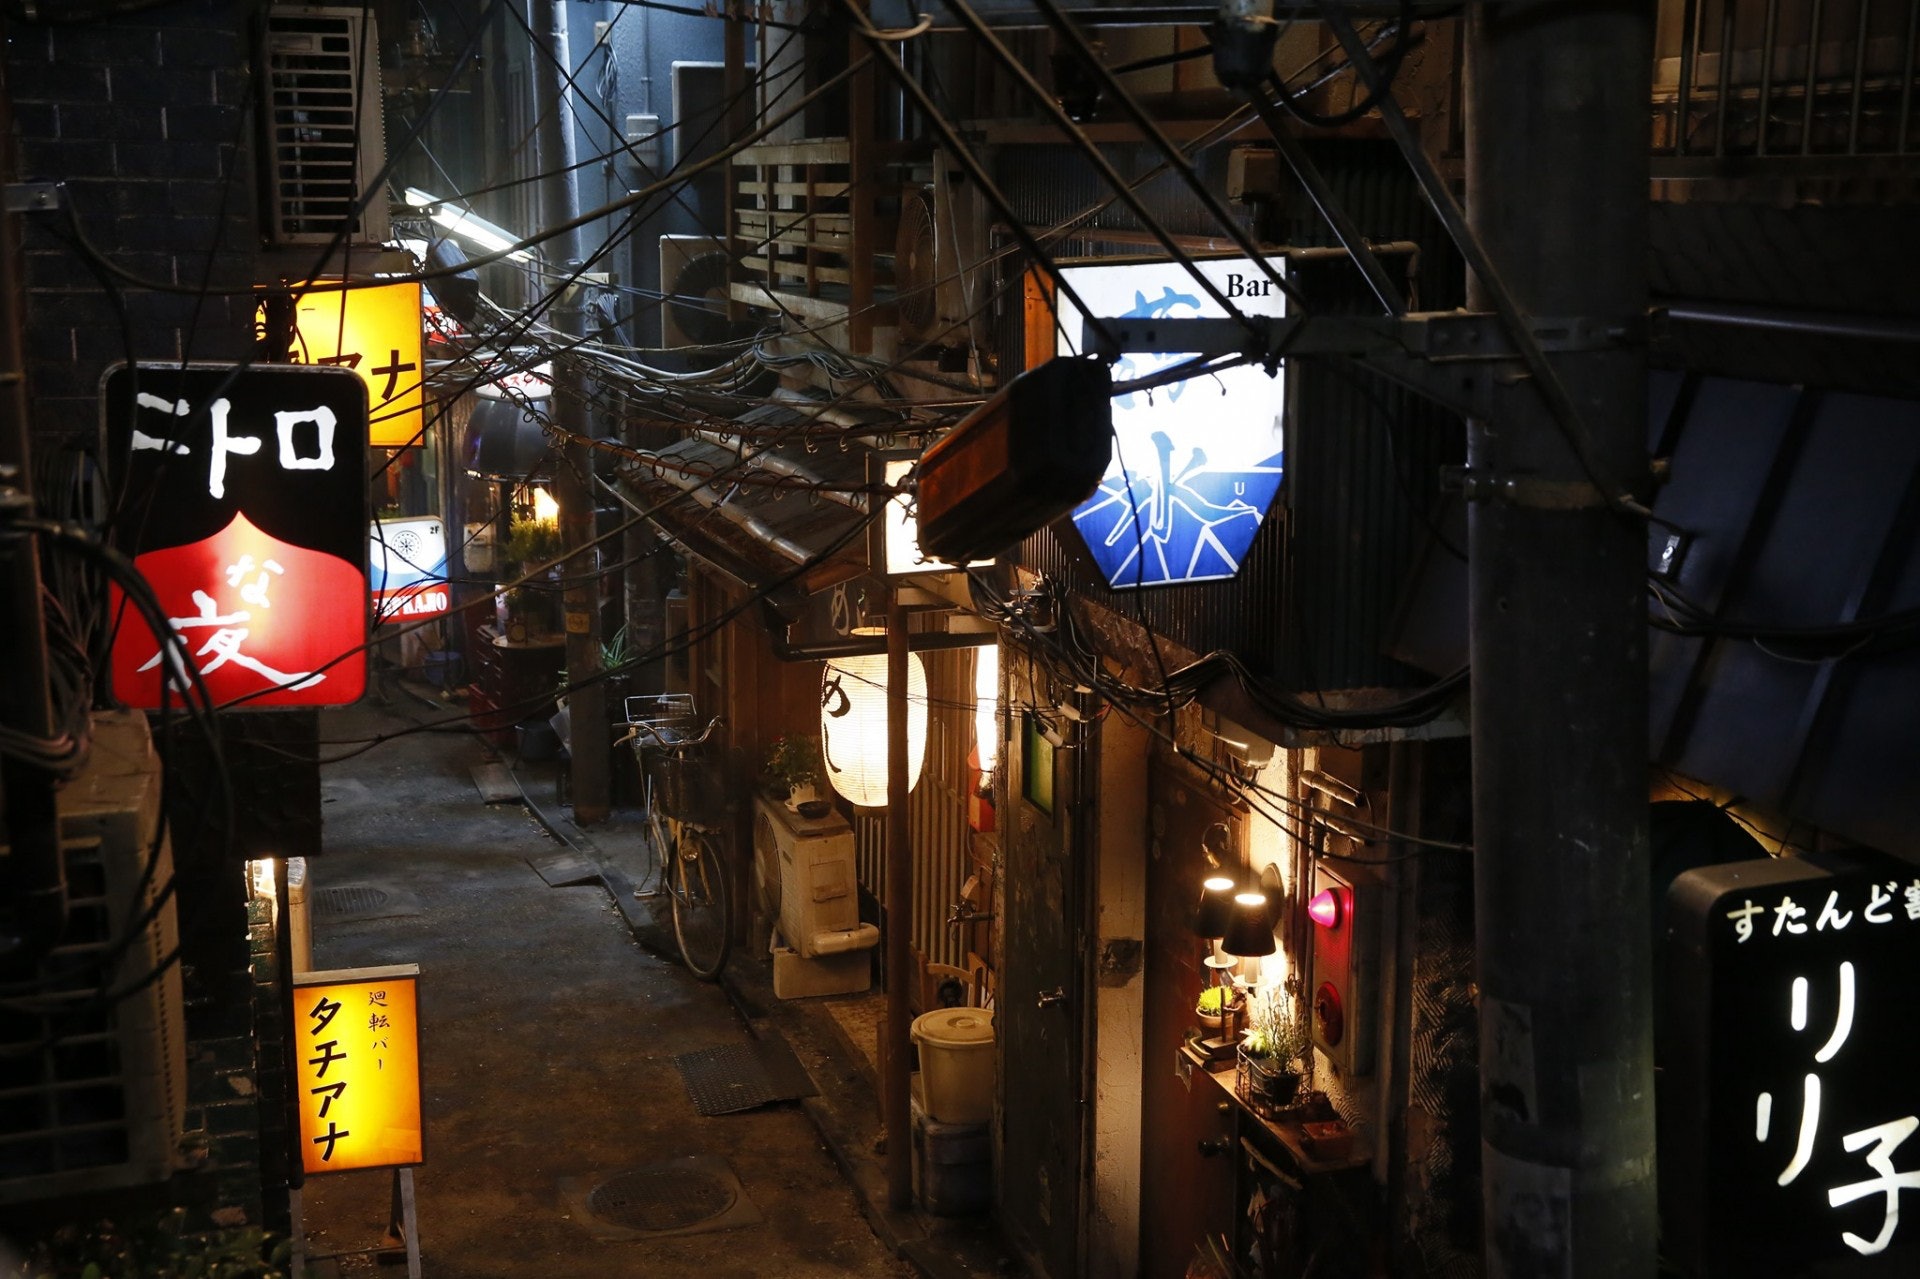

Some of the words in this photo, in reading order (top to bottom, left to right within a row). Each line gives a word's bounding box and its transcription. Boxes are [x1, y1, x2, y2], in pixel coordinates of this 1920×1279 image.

[1227, 273, 1272, 298] Bar
[368, 991, 391, 1071] 廻転バー
[309, 997, 350, 1162] タチアナ
